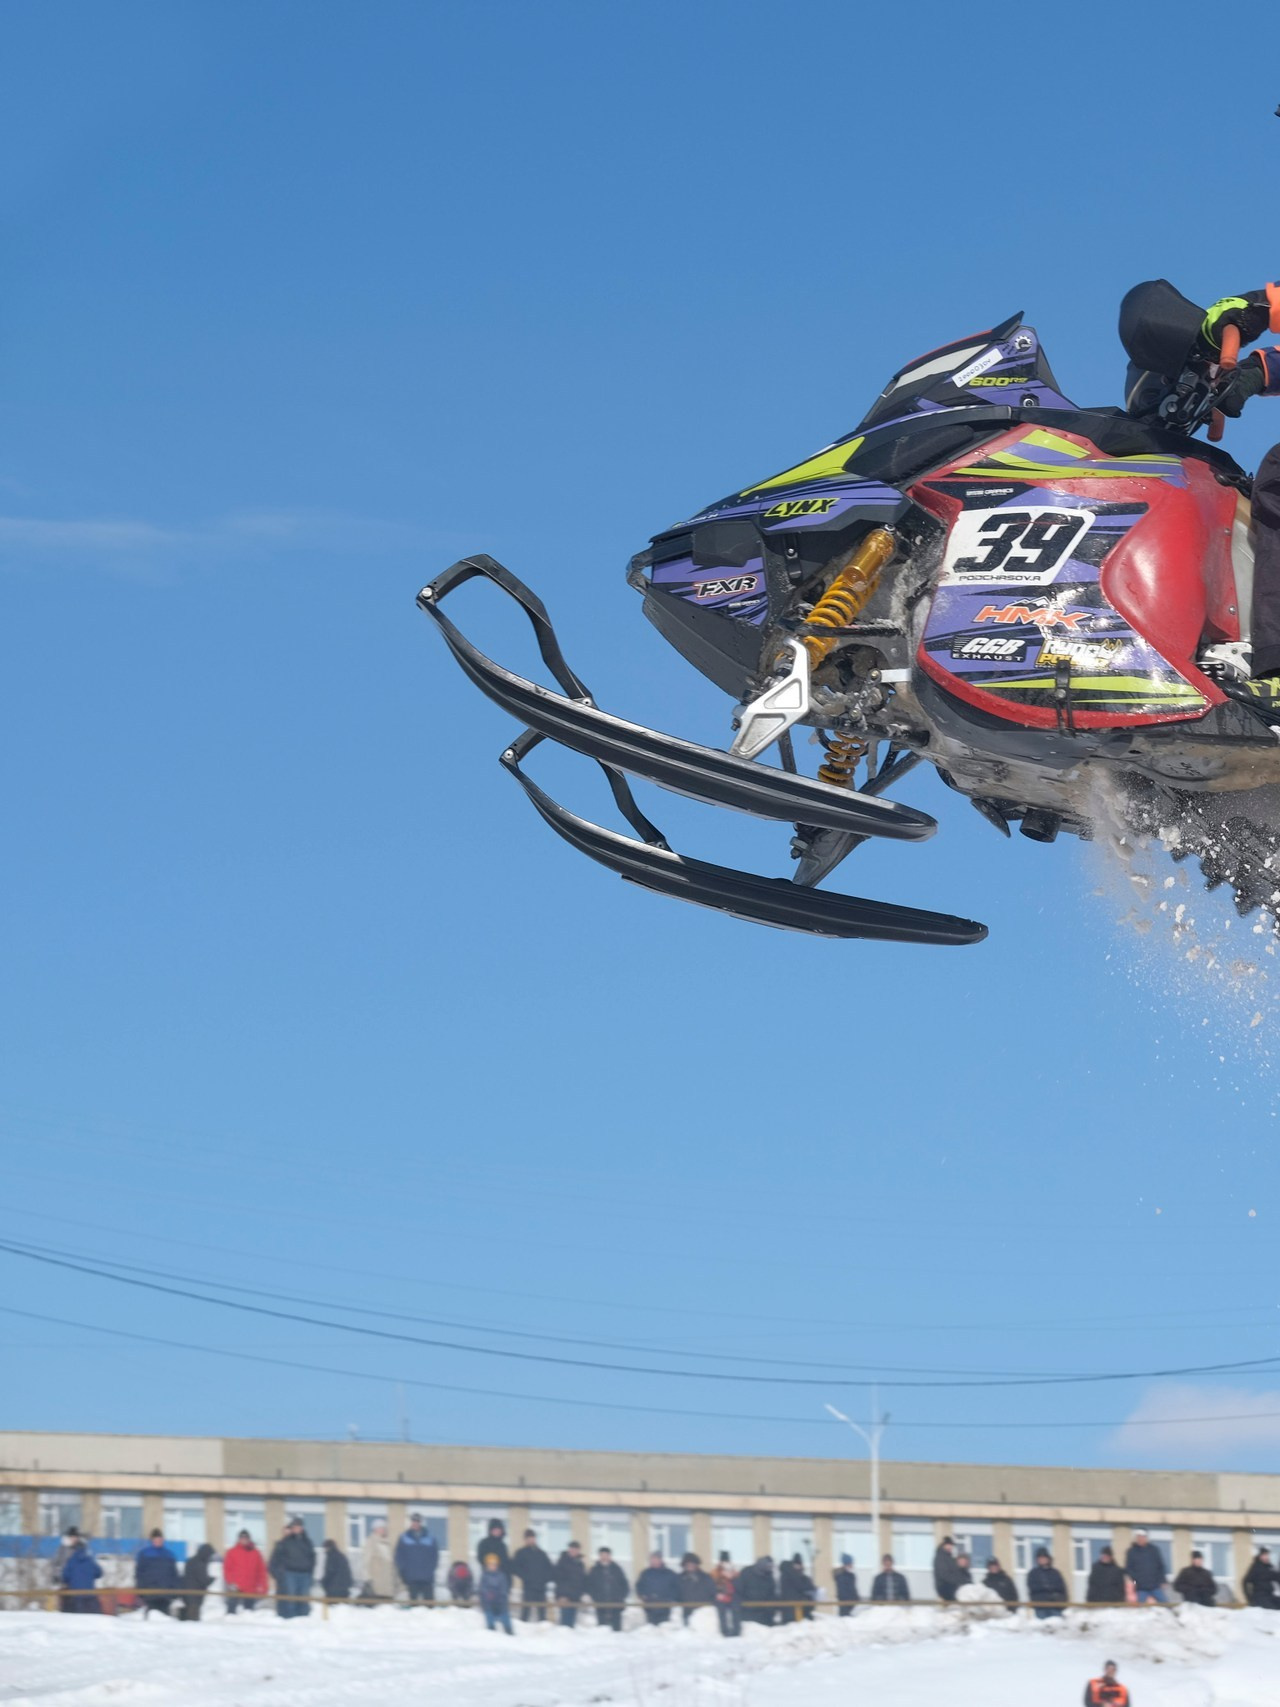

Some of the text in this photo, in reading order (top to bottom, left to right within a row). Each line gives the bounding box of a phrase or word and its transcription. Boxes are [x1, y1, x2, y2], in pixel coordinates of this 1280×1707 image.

[765, 498, 841, 518] LYNX
[952, 512, 1085, 573] 39
[695, 575, 758, 599] FXR
[973, 605, 1092, 629] HMK
[960, 637, 1026, 655] GGB
[952, 653, 1022, 662] EXHAUST
